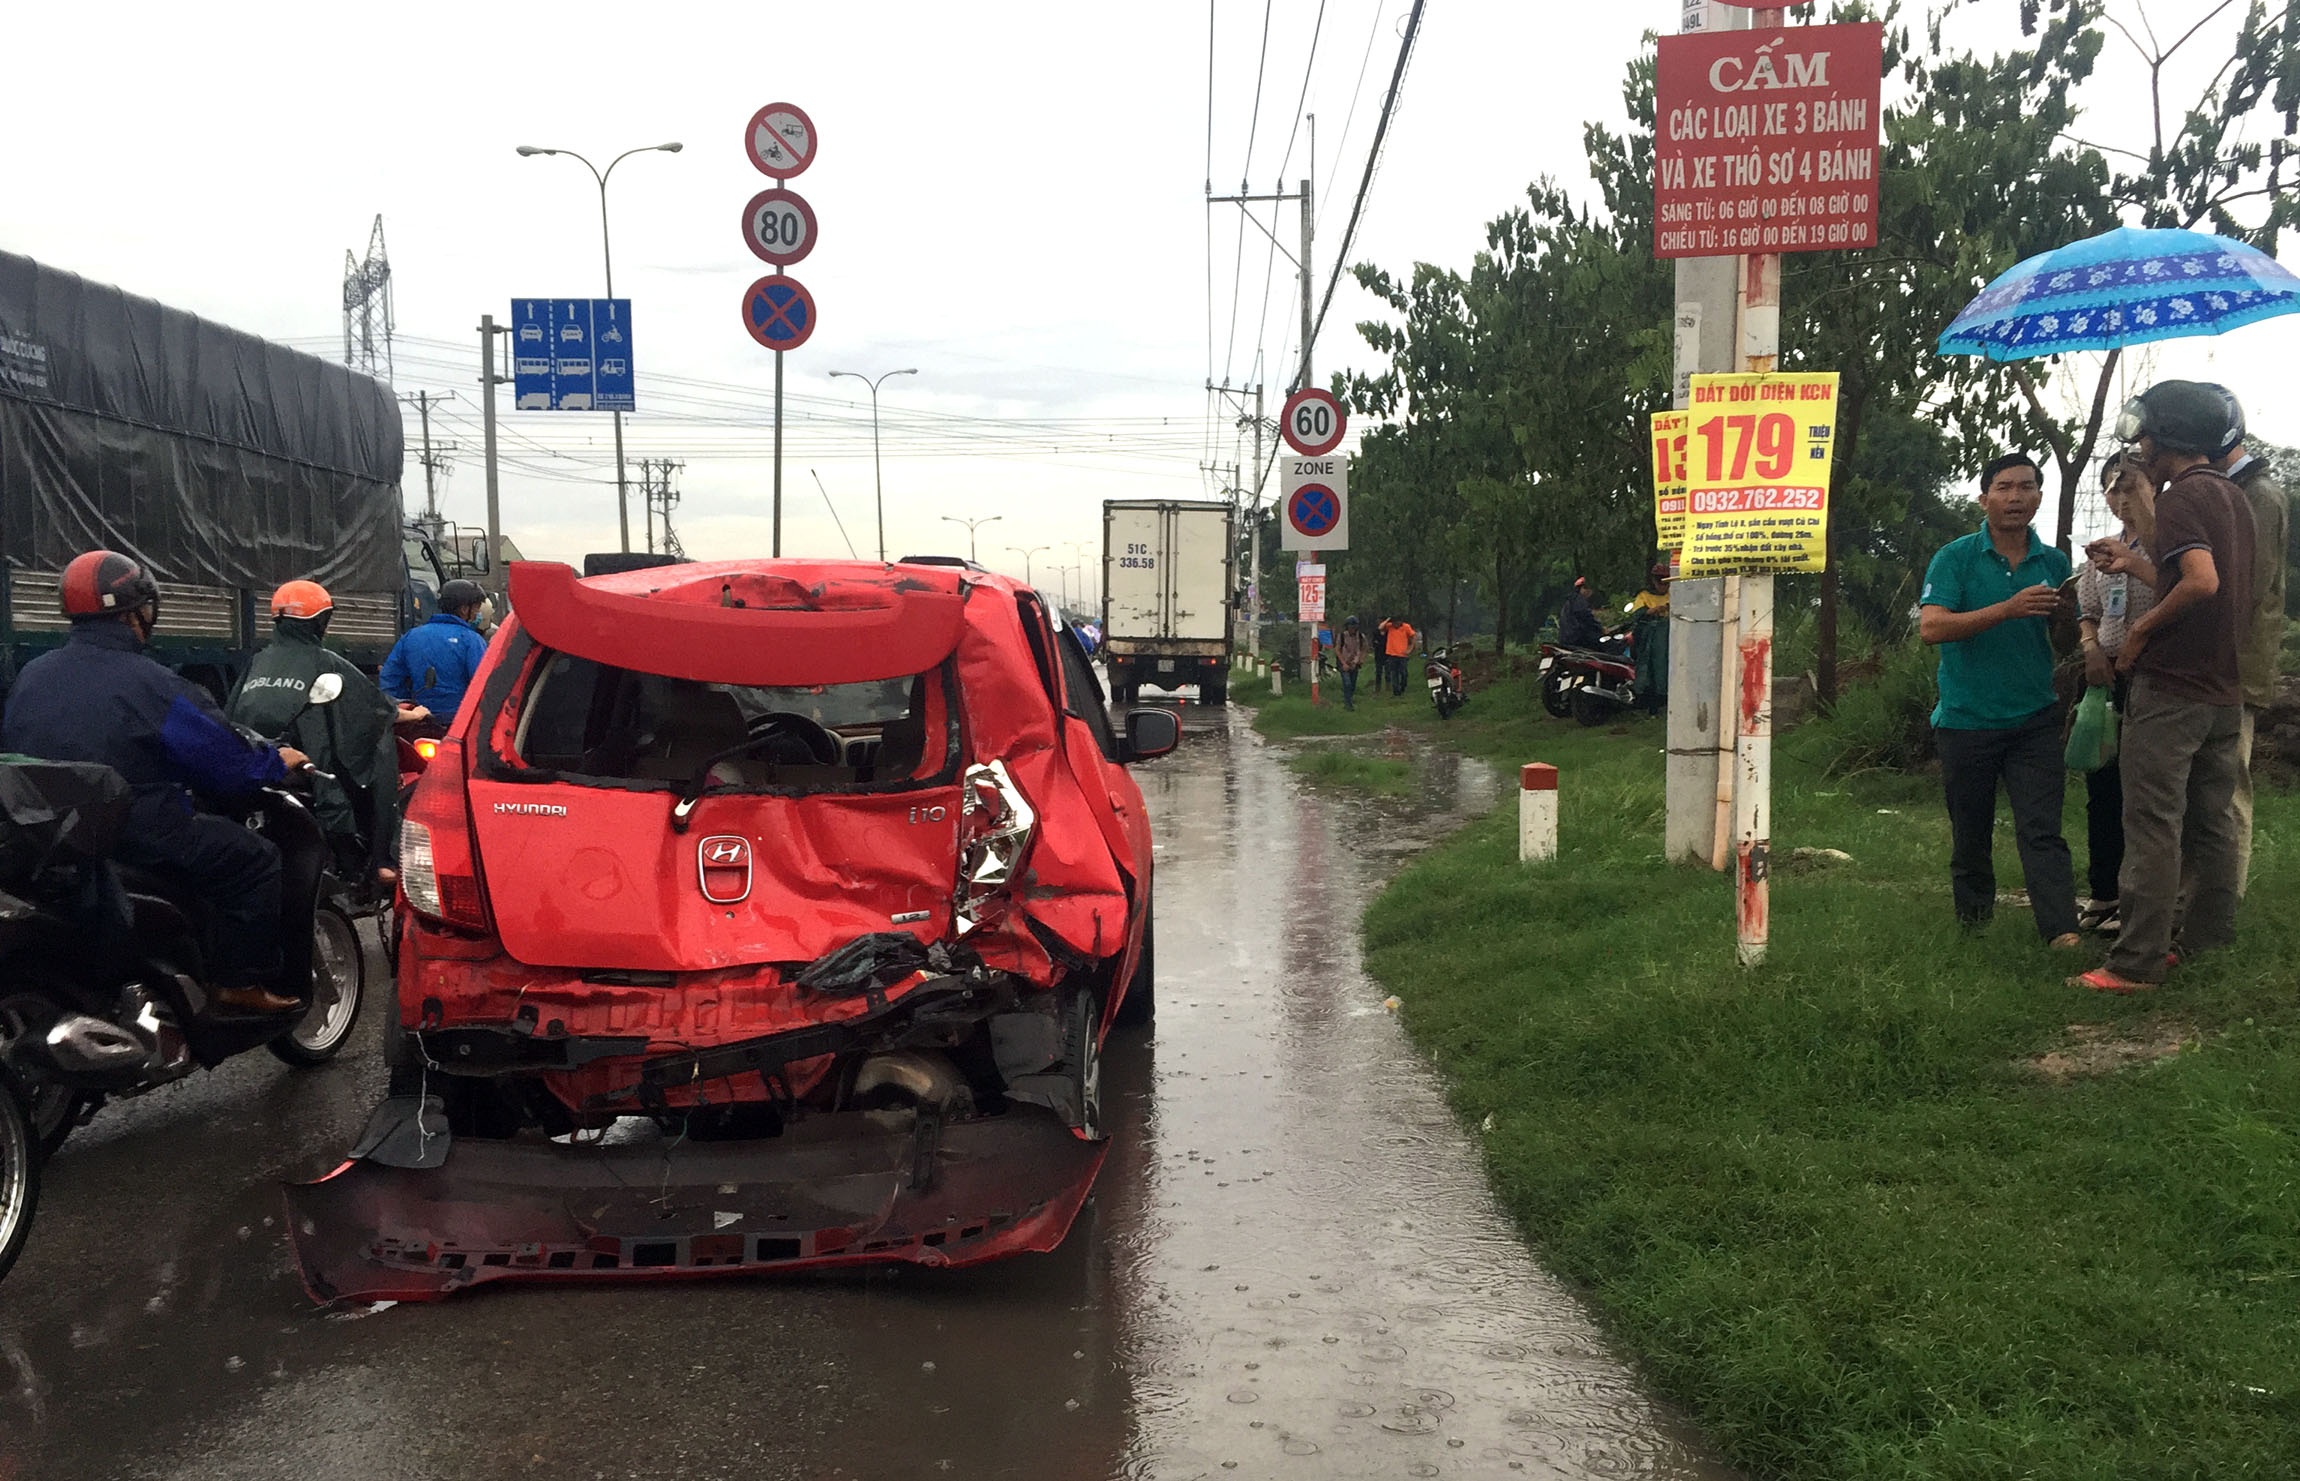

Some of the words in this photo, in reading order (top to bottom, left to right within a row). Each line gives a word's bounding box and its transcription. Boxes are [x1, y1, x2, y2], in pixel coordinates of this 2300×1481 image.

[1708, 37, 1831, 93] CẤM
[1669, 99, 1708, 141] CÁC
[1713, 105, 1757, 144] LOẠI
[1763, 103, 1788, 136] XE
[1794, 102, 1807, 135] 3
[1813, 91, 1867, 133] BÁNH
[1661, 149, 1686, 190] VÀ
[1692, 155, 1717, 188] XE
[1723, 145, 1762, 186] THÔ
[1768, 147, 1796, 185] SƠ
[1799, 151, 1812, 183] 4
[1818, 141, 1873, 182] BÁNH
[1661, 198, 1692, 223] SÁNG
[1696, 195, 1716, 221] TỪ:
[1719, 200, 1734, 220] 06
[1738, 193, 1757, 219] GIỜ
[1762, 198, 1777, 219] 00
[1780, 190, 1808, 217] ĐẾN
[1809, 196, 1825, 215] 08
[1828, 190, 1850, 214] GIỜ
[1853, 194, 1869, 213] 00
[761, 210, 798, 246] 80
[1660, 224, 1696, 250] CHIỀU
[1699, 223, 1718, 249] TỪ:
[1722, 228, 1736, 248] 16
[1740, 221, 1761, 247] GIỜ
[1763, 227, 1778, 246] 00
[1781, 218, 1809, 245] ĐẾN
[1810, 224, 1825, 243] 19
[1828, 218, 1850, 243] GIỜ
[1852, 223, 1868, 242] 00
[1761, 381, 1795, 404] DIỆN
[1800, 384, 1832, 401] KCN
[1296, 406, 1329, 436] 60
[1697, 413, 1795, 481] 179
[1294, 462, 1334, 475] ZONE
[1694, 489, 1820, 512] 0932.762.252
[1128, 543, 1147, 555] 51C
[1120, 557, 1154, 569] 336.58
[1301, 585, 1318, 602] 125
[493, 803, 567, 817] HYUNDAI
[909, 806, 946, 824] i10
